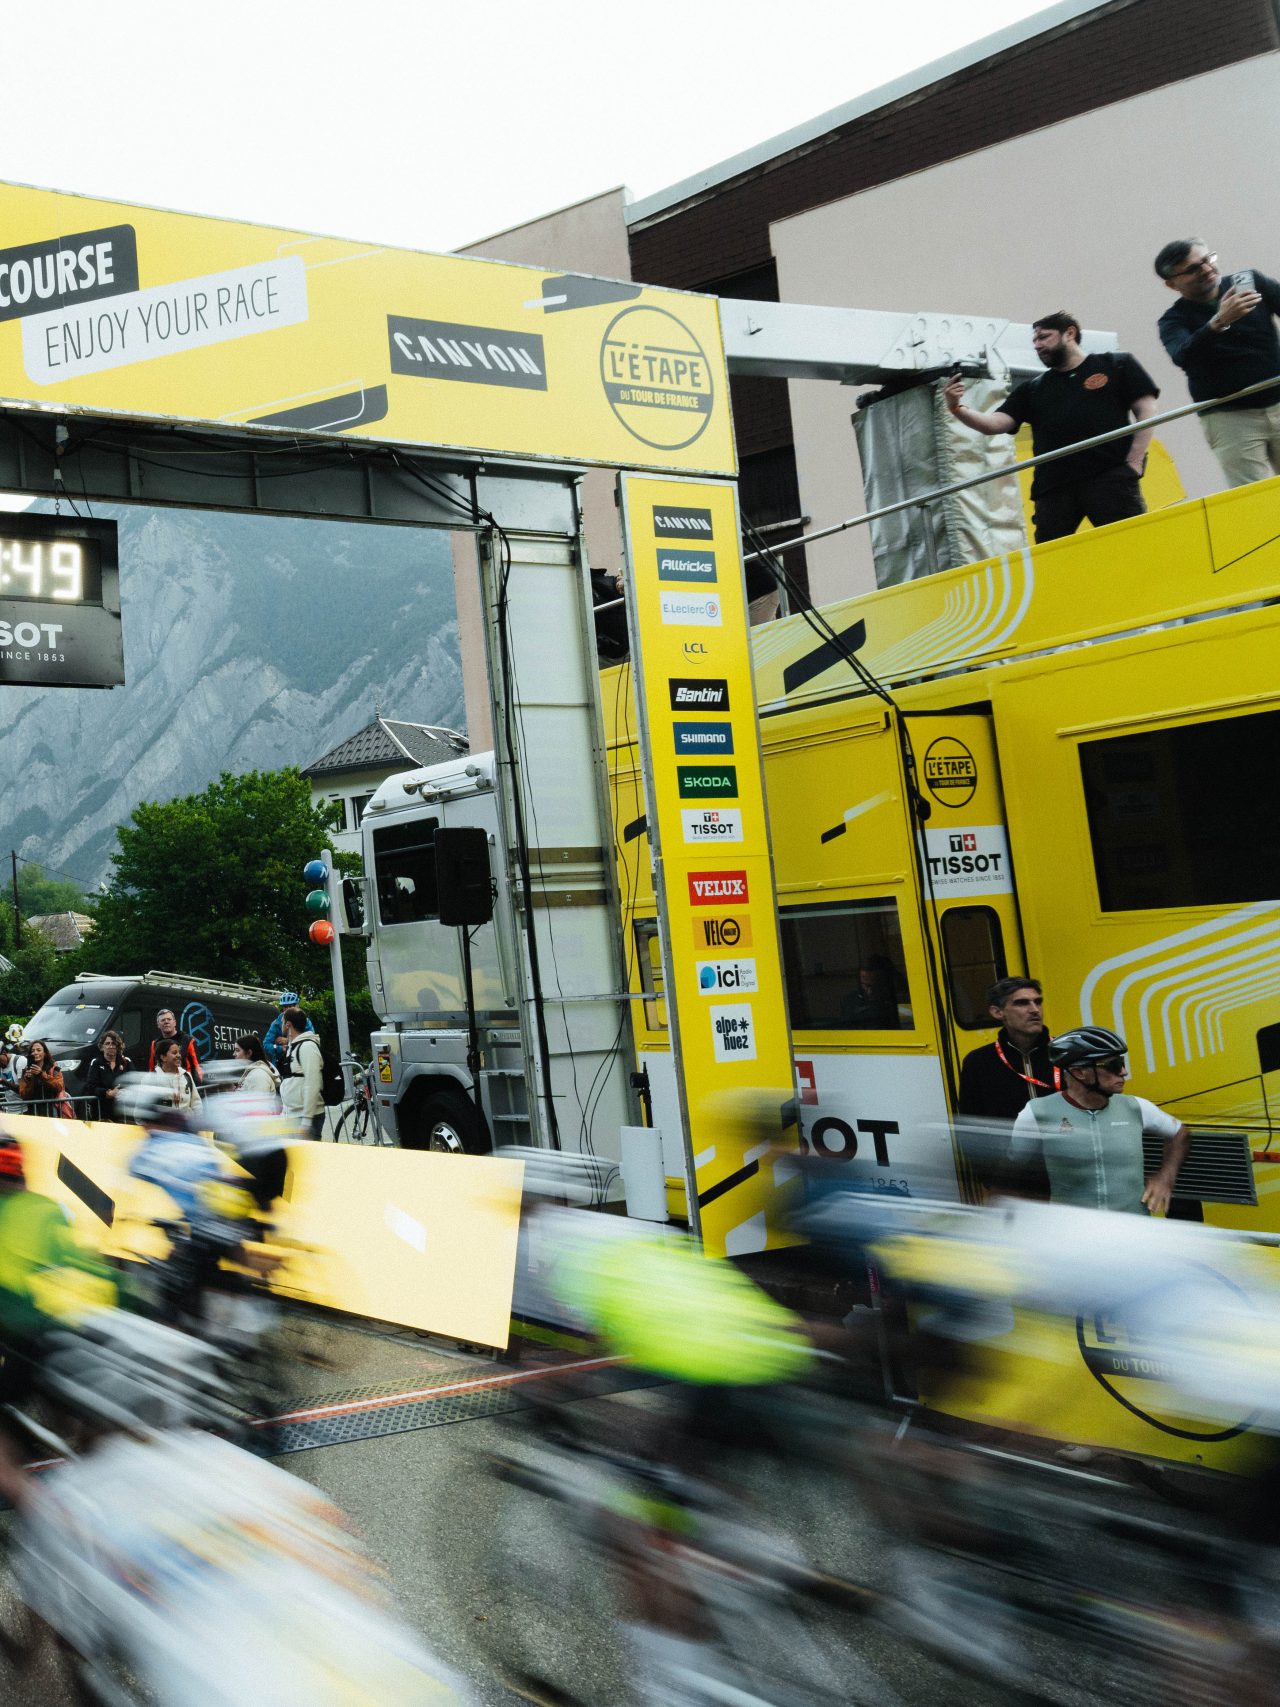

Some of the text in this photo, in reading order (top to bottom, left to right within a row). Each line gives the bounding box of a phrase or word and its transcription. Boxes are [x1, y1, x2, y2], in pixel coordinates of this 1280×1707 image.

[45, 275, 281, 368] ENJOY YOUR RACE
[393, 332, 542, 376] CANYON
[620, 389, 699, 409] DU TOUR DE FRANCE
[654, 515, 712, 531] CANYON
[661, 559, 713, 573] Alltricks
[684, 642, 708, 654] LCL
[37, 652, 65, 663] 1853
[675, 687, 723, 703] Santini
[680, 733, 726, 744] SHIMANO
[691, 823, 734, 835] TISSOT
[927, 853, 1002, 876] TISSOT
[716, 963, 741, 988] ici
[715, 1016, 738, 1037] alpe
[723, 1033, 749, 1051] huez
[1111, 1357, 1130, 1372] DU
